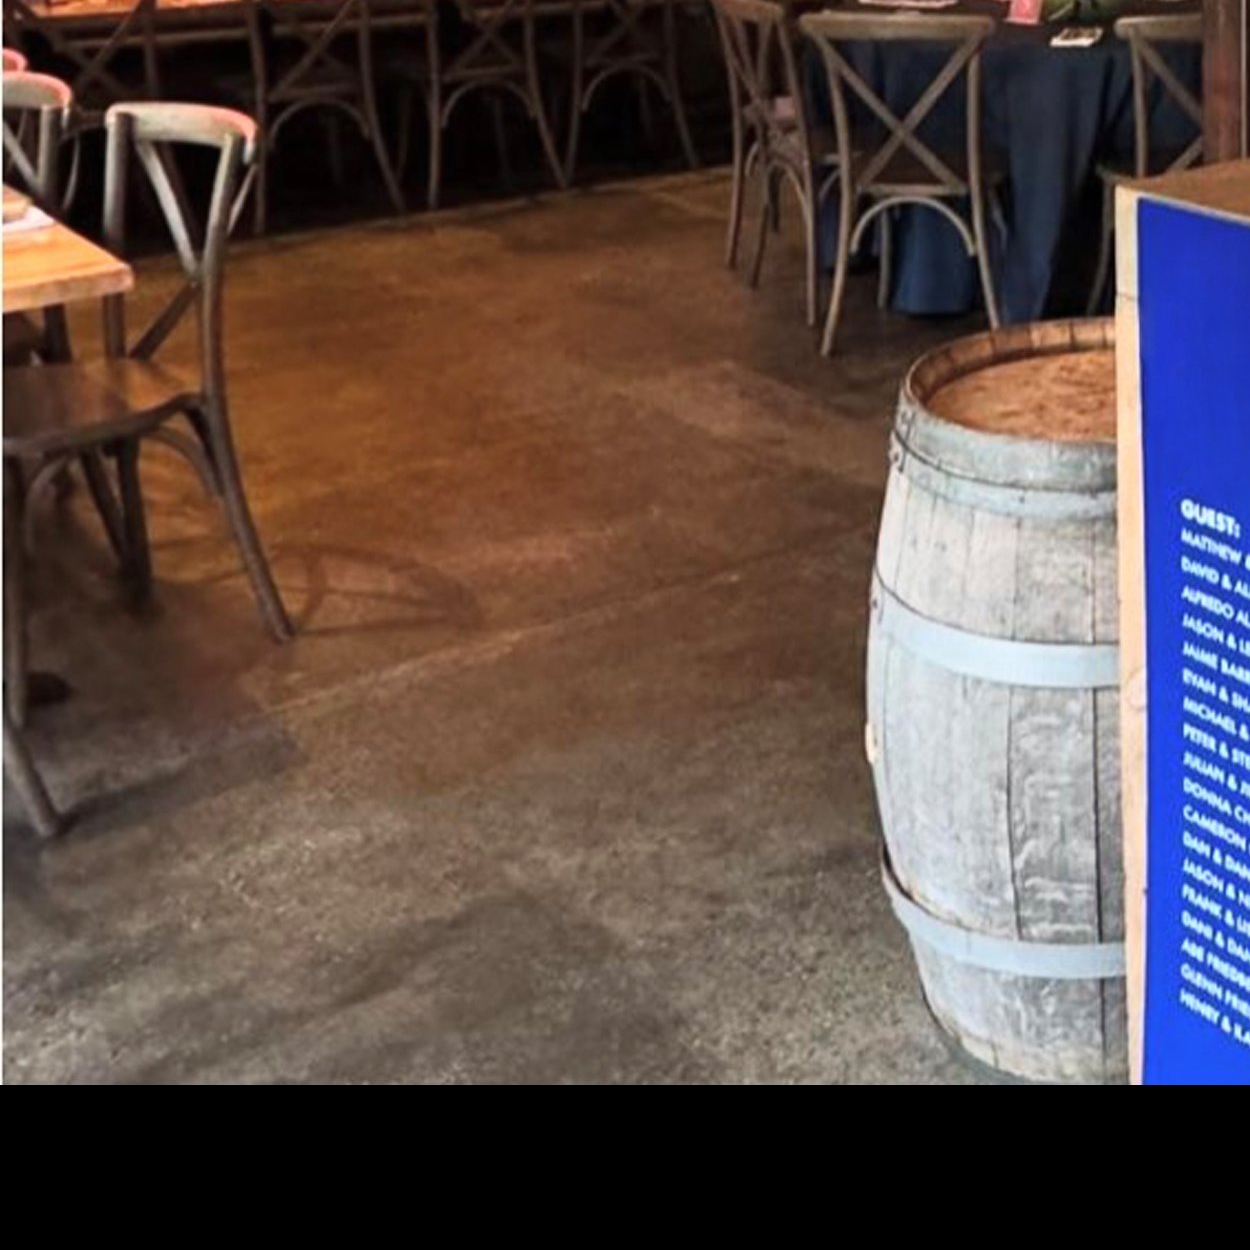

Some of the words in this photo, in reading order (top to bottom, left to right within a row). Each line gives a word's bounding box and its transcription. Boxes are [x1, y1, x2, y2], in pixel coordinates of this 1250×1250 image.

[1181, 499, 1240, 538] GUEST:
[1181, 528, 1242, 564] MATTHEW
[1181, 556, 1219, 584] DAVID
